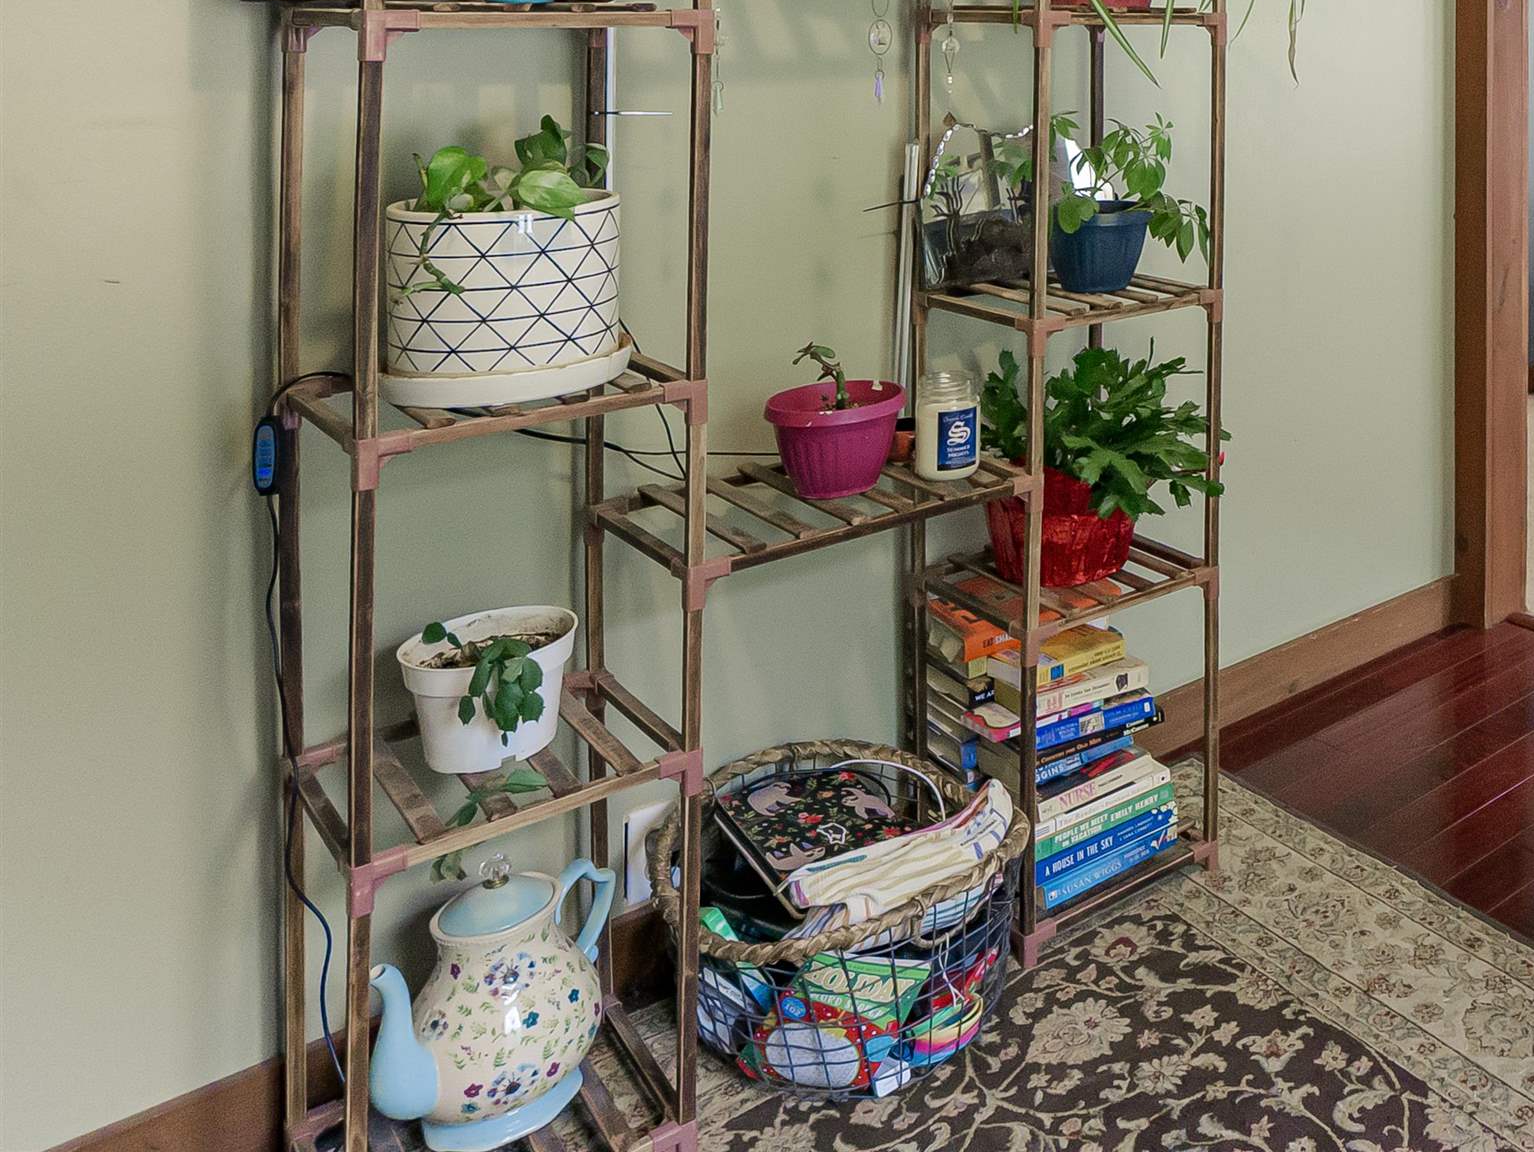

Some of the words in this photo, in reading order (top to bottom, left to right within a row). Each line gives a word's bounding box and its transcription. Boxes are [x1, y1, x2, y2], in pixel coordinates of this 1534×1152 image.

[1058, 781, 1096, 808] NURSE
[1110, 805, 1133, 822] EMILY
[1135, 795, 1159, 810] HENRY
[1045, 865, 1050, 877] A
[1052, 854, 1075, 874] HOUSE
[1076, 849, 1085, 862] IN
[1086, 842, 1099, 857] THE
[1101, 835, 1113, 850] SKY
[1062, 877, 1092, 895] SUSAN
[1093, 861, 1122, 880] WIGGS
